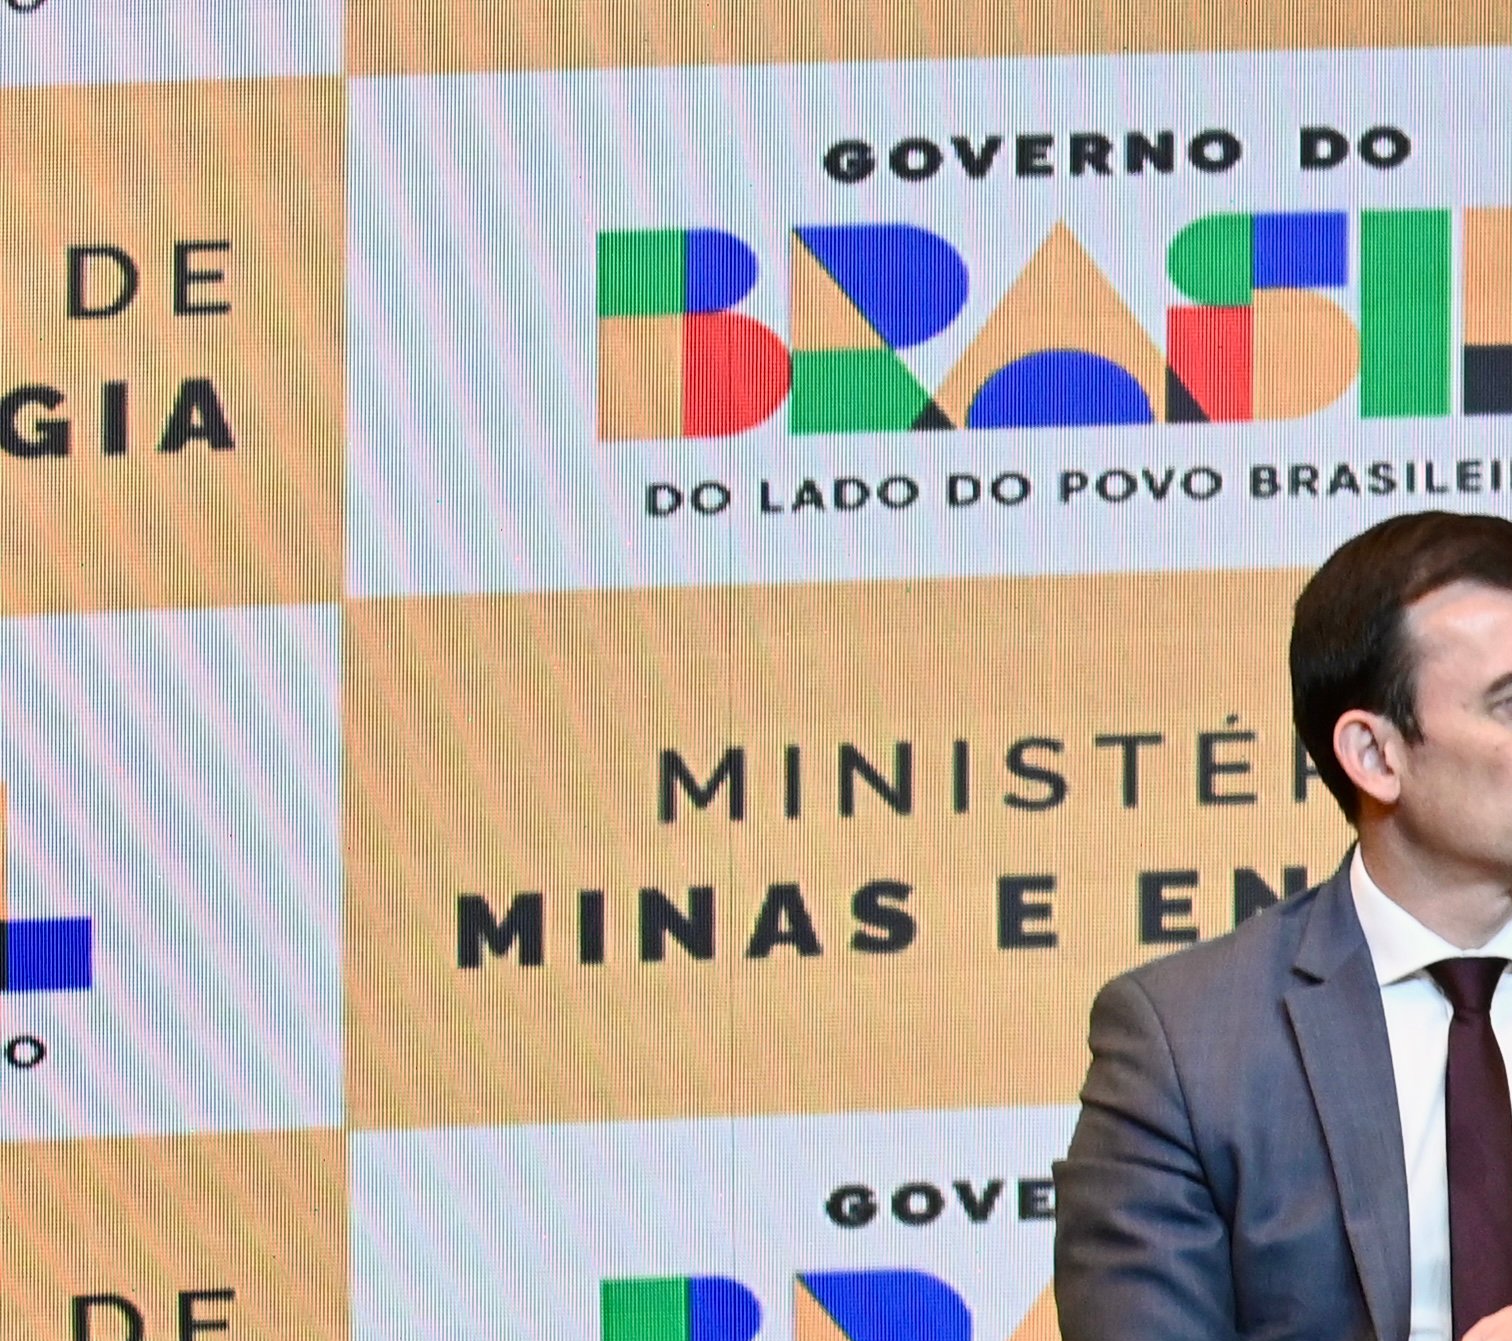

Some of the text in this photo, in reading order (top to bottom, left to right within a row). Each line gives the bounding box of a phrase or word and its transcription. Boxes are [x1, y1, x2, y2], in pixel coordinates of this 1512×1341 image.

[822, 126, 1411, 184] GOVERNO DO
[66, 240, 231, 320] DE
[645, 481, 732, 518] DO
[759, 475, 920, 514] LADO
[946, 472, 1032, 508] DO
[1059, 466, 1223, 503] POVO
[655, 712, 1318, 822] MINISTÉ
[457, 880, 916, 969] MINAS
[997, 874, 1058, 950] E
[825, 1178, 1056, 1228] GOVE
